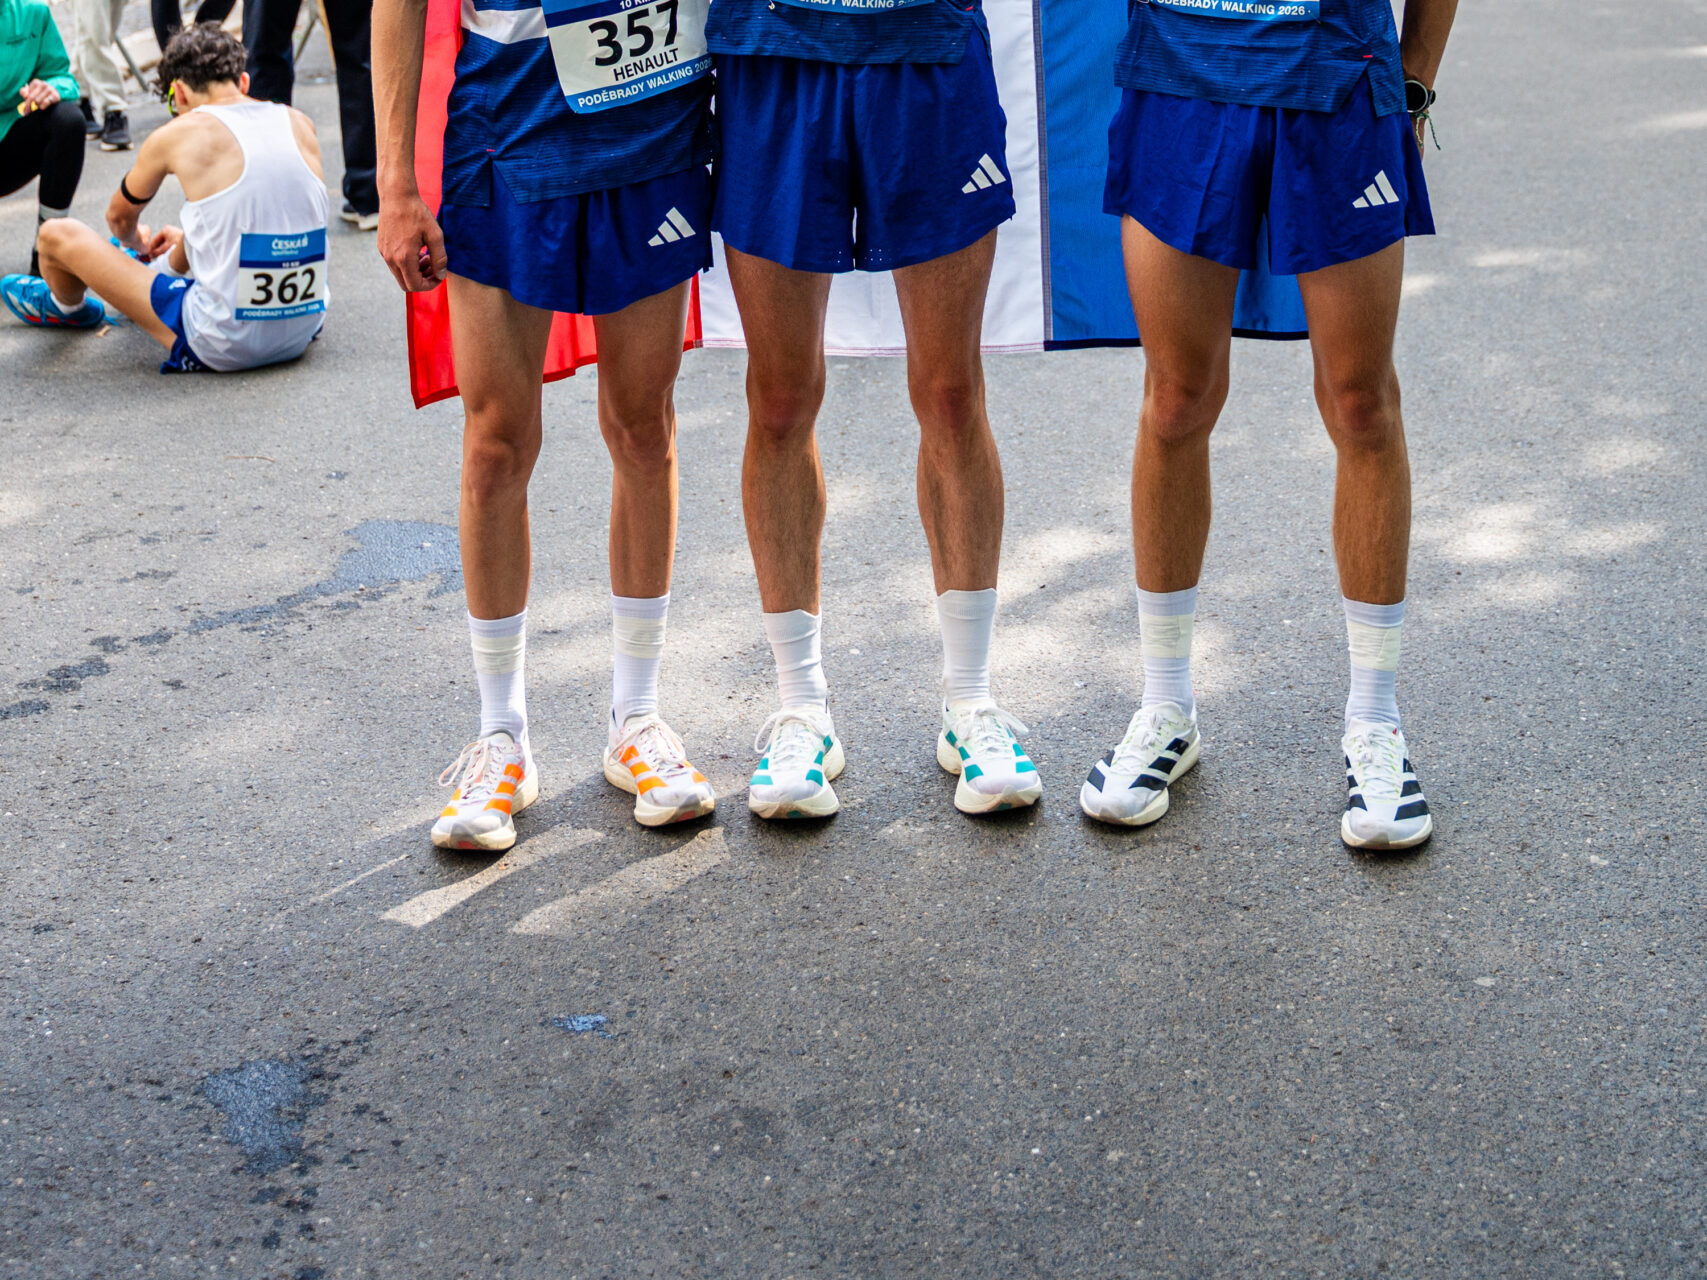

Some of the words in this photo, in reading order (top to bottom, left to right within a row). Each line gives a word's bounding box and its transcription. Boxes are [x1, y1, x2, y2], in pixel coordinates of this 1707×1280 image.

[619, 0, 632, 10] 10
[1221, 1, 1275, 15] WALKING
[1277, 6, 1306, 16] 2026
[613, 48, 679, 81] HENAULT
[577, 81, 646, 108] PODĚBRADY
[646, 66, 693, 89] WALKING
[250, 267, 316, 306] 362
